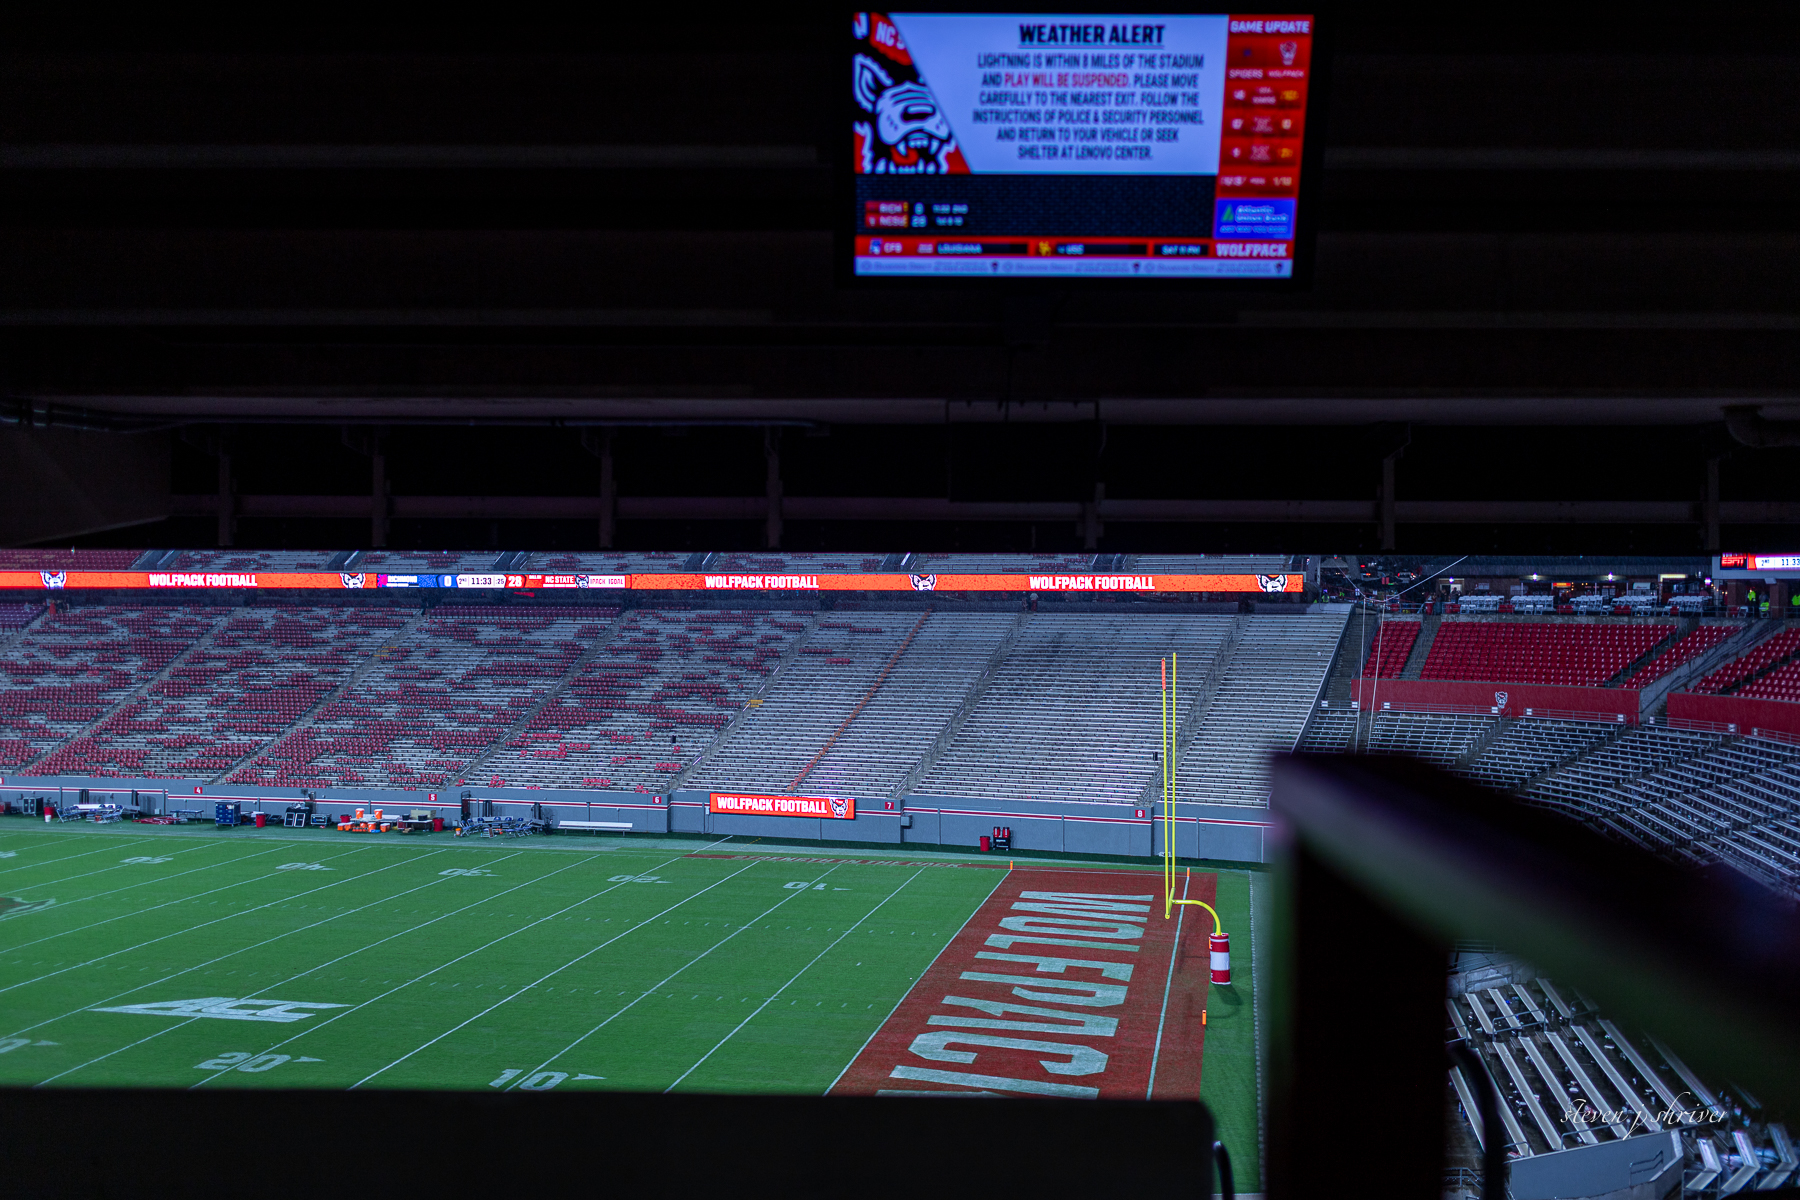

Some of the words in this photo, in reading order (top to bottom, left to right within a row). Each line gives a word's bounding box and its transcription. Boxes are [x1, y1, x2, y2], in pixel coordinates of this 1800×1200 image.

[1230, 20, 1264, 33] GAME
[1265, 20, 1310, 33] UPDATE
[1019, 24, 1107, 45] WEATHER
[1109, 24, 1165, 45] ALERT
[978, 52, 1031, 69] LIGHTNING
[1032, 52, 1043, 69] IS
[1045, 52, 1081, 69] WITHIN
[1082, 52, 1090, 69] 8
[1091, 52, 1121, 69] MILES
[1122, 52, 1135, 69] OF
[1137, 52, 1157, 69] THE
[1159, 52, 1205, 70] STADIUM
[981, 72, 1003, 88] AND
[1004, 72, 1030, 88] PLAY
[1031, 72, 1055, 88] WILL
[1056, 72, 1069, 88] BE
[1071, 72, 1131, 88] SUSPENDED.
[1133, 72, 1170, 88] PLEASE
[1171, 72, 1200, 88] MOVE
[1229, 69, 1264, 79] SPIDERS
[1268, 70, 1305, 79] WOLFPACK
[979, 91, 1035, 107] CAREFULLY
[1035, 91, 1048, 107] TO
[1049, 91, 1068, 107] THE
[1070, 91, 1112, 107] NEAREST
[1114, 91, 1138, 107] EXIT.
[1140, 91, 1180, 107] FOLLOW
[1181, 91, 1200, 107] THE
[973, 109, 1041, 124] INSTRUCTIONS
[1043, 109, 1056, 124] OF
[1058, 109, 1090, 124] POLICE
[1092, 109, 1101, 124] &
[1101, 109, 1149, 124] SECURITY
[1150, 109, 1204, 125] PERSONNEL
[996, 127, 1017, 142] AND
[1018, 127, 1056, 142] RETURN
[1057, 127, 1071, 142] TO
[1073, 127, 1099, 142] YOUR
[1100, 127, 1139, 142] VEHICLE
[1140, 127, 1154, 142] OR
[1156, 127, 1180, 142] SEEK
[1017, 144, 1060, 160] SHELTER
[1061, 144, 1074, 160] AT
[1075, 144, 1113, 160] LENOVO
[1115, 144, 1153, 160] CENTER.
[1216, 243, 1287, 257] WOLFPACK
[1721, 556, 1744, 567] ESPN
[149, 573, 205, 587] WOLFPACK
[206, 573, 257, 587] FOOTBALL
[444, 575, 452, 587] 0
[471, 577, 492, 585] 11:33
[508, 576, 522, 587] 28
[545, 576, 554, 584] NC
[555, 576, 574, 584] STATE
[705, 575, 763, 589] WOLFPACK
[764, 575, 819, 589] FOOTBALL
[1029, 576, 1093, 590] WOLFPACK
[1095, 576, 1155, 590] FOOTBALL
[717, 796, 773, 812] WOLFPACK
[775, 798, 828, 814] FOOTBALL
[87, 996, 356, 1023] ACC
[193, 1052, 291, 1073] 20
[488, 1068, 569, 1091] 10
